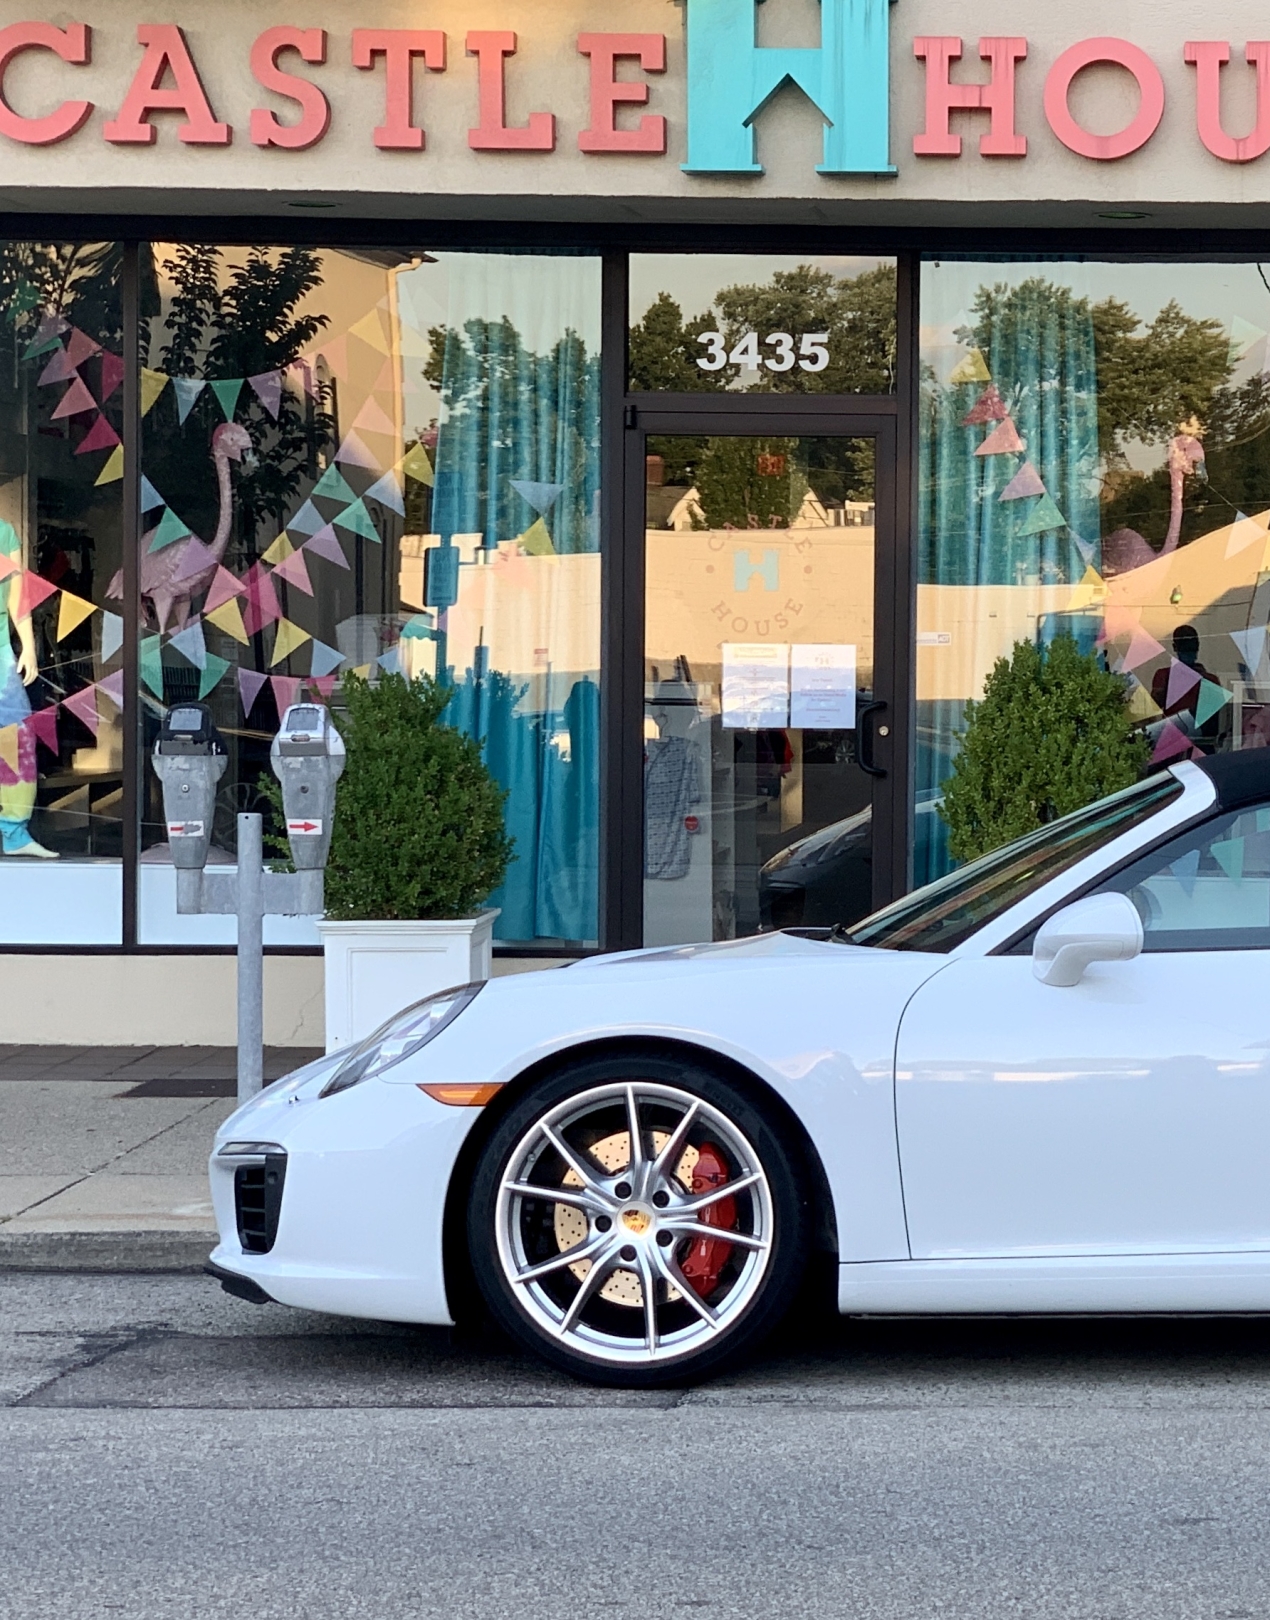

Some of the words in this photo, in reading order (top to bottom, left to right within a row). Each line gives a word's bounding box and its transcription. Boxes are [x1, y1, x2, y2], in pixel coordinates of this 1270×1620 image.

[0, 22, 668, 155] CASTLE
[696, 331, 830, 371] 3435
[708, 513, 813, 554] CASTLE
[711, 598, 803, 637] HOUSE
